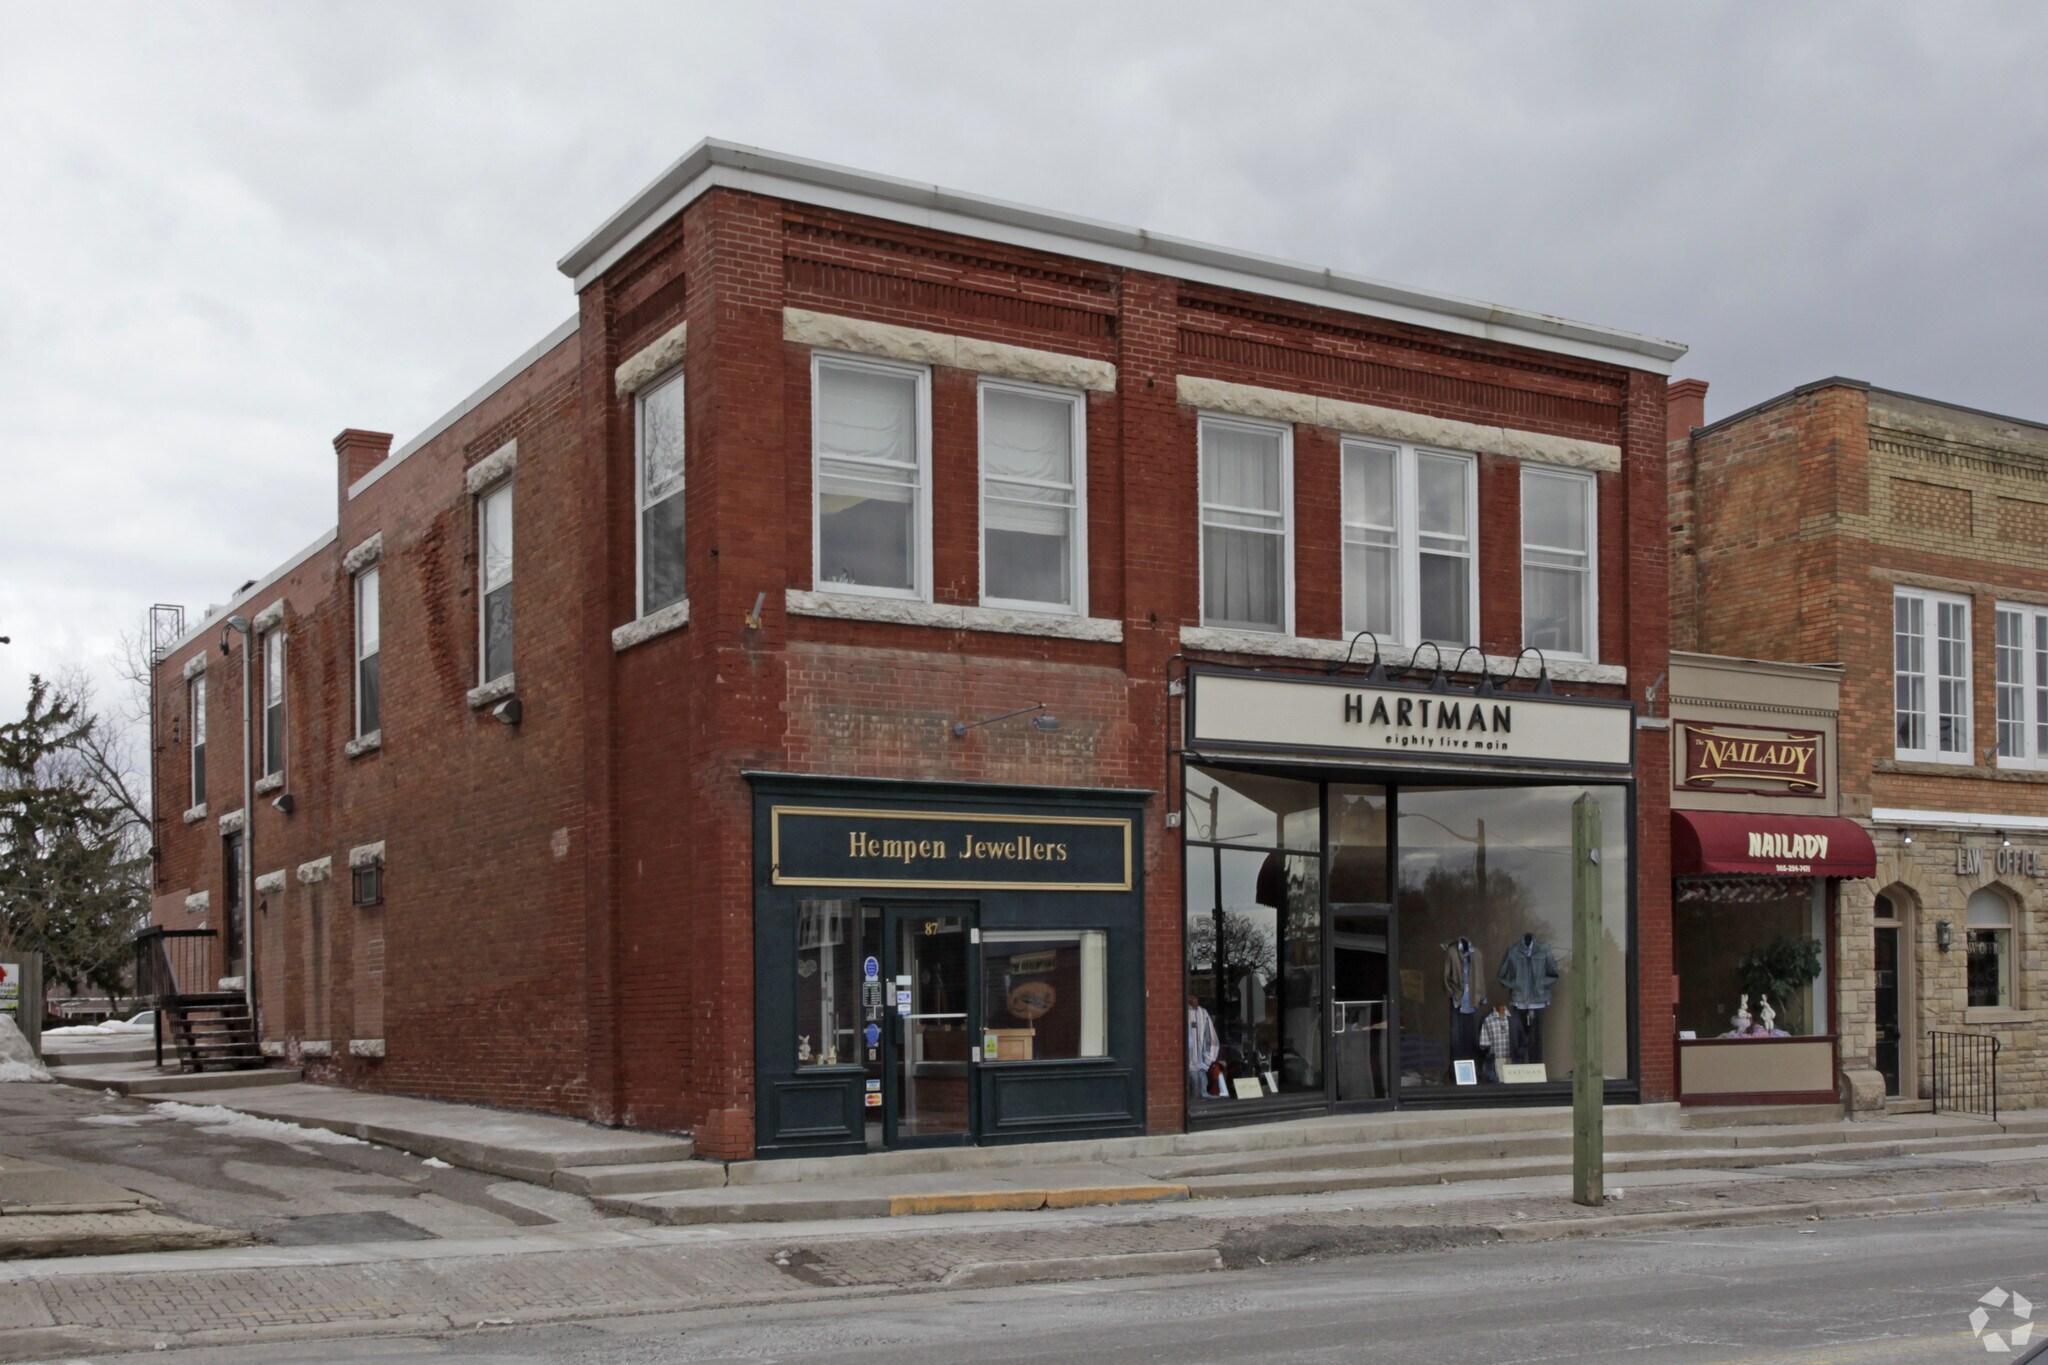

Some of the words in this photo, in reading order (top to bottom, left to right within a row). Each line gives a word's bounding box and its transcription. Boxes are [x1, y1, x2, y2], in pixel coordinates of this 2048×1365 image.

[1345, 693, 1511, 733] HARTMAN
[1386, 735, 1434, 747] eighty
[1440, 737, 1468, 748] five
[1475, 740, 1508, 750] main
[1700, 740, 1815, 774] NAILADY
[849, 831, 946, 864] Hempen
[959, 834, 1067, 861] Jewellers
[1748, 832, 1828, 859] NAILADY
[1956, 846, 1985, 875] LAW
[1995, 847, 2041, 877] OFFICE
[925, 922, 938, 936] 87
